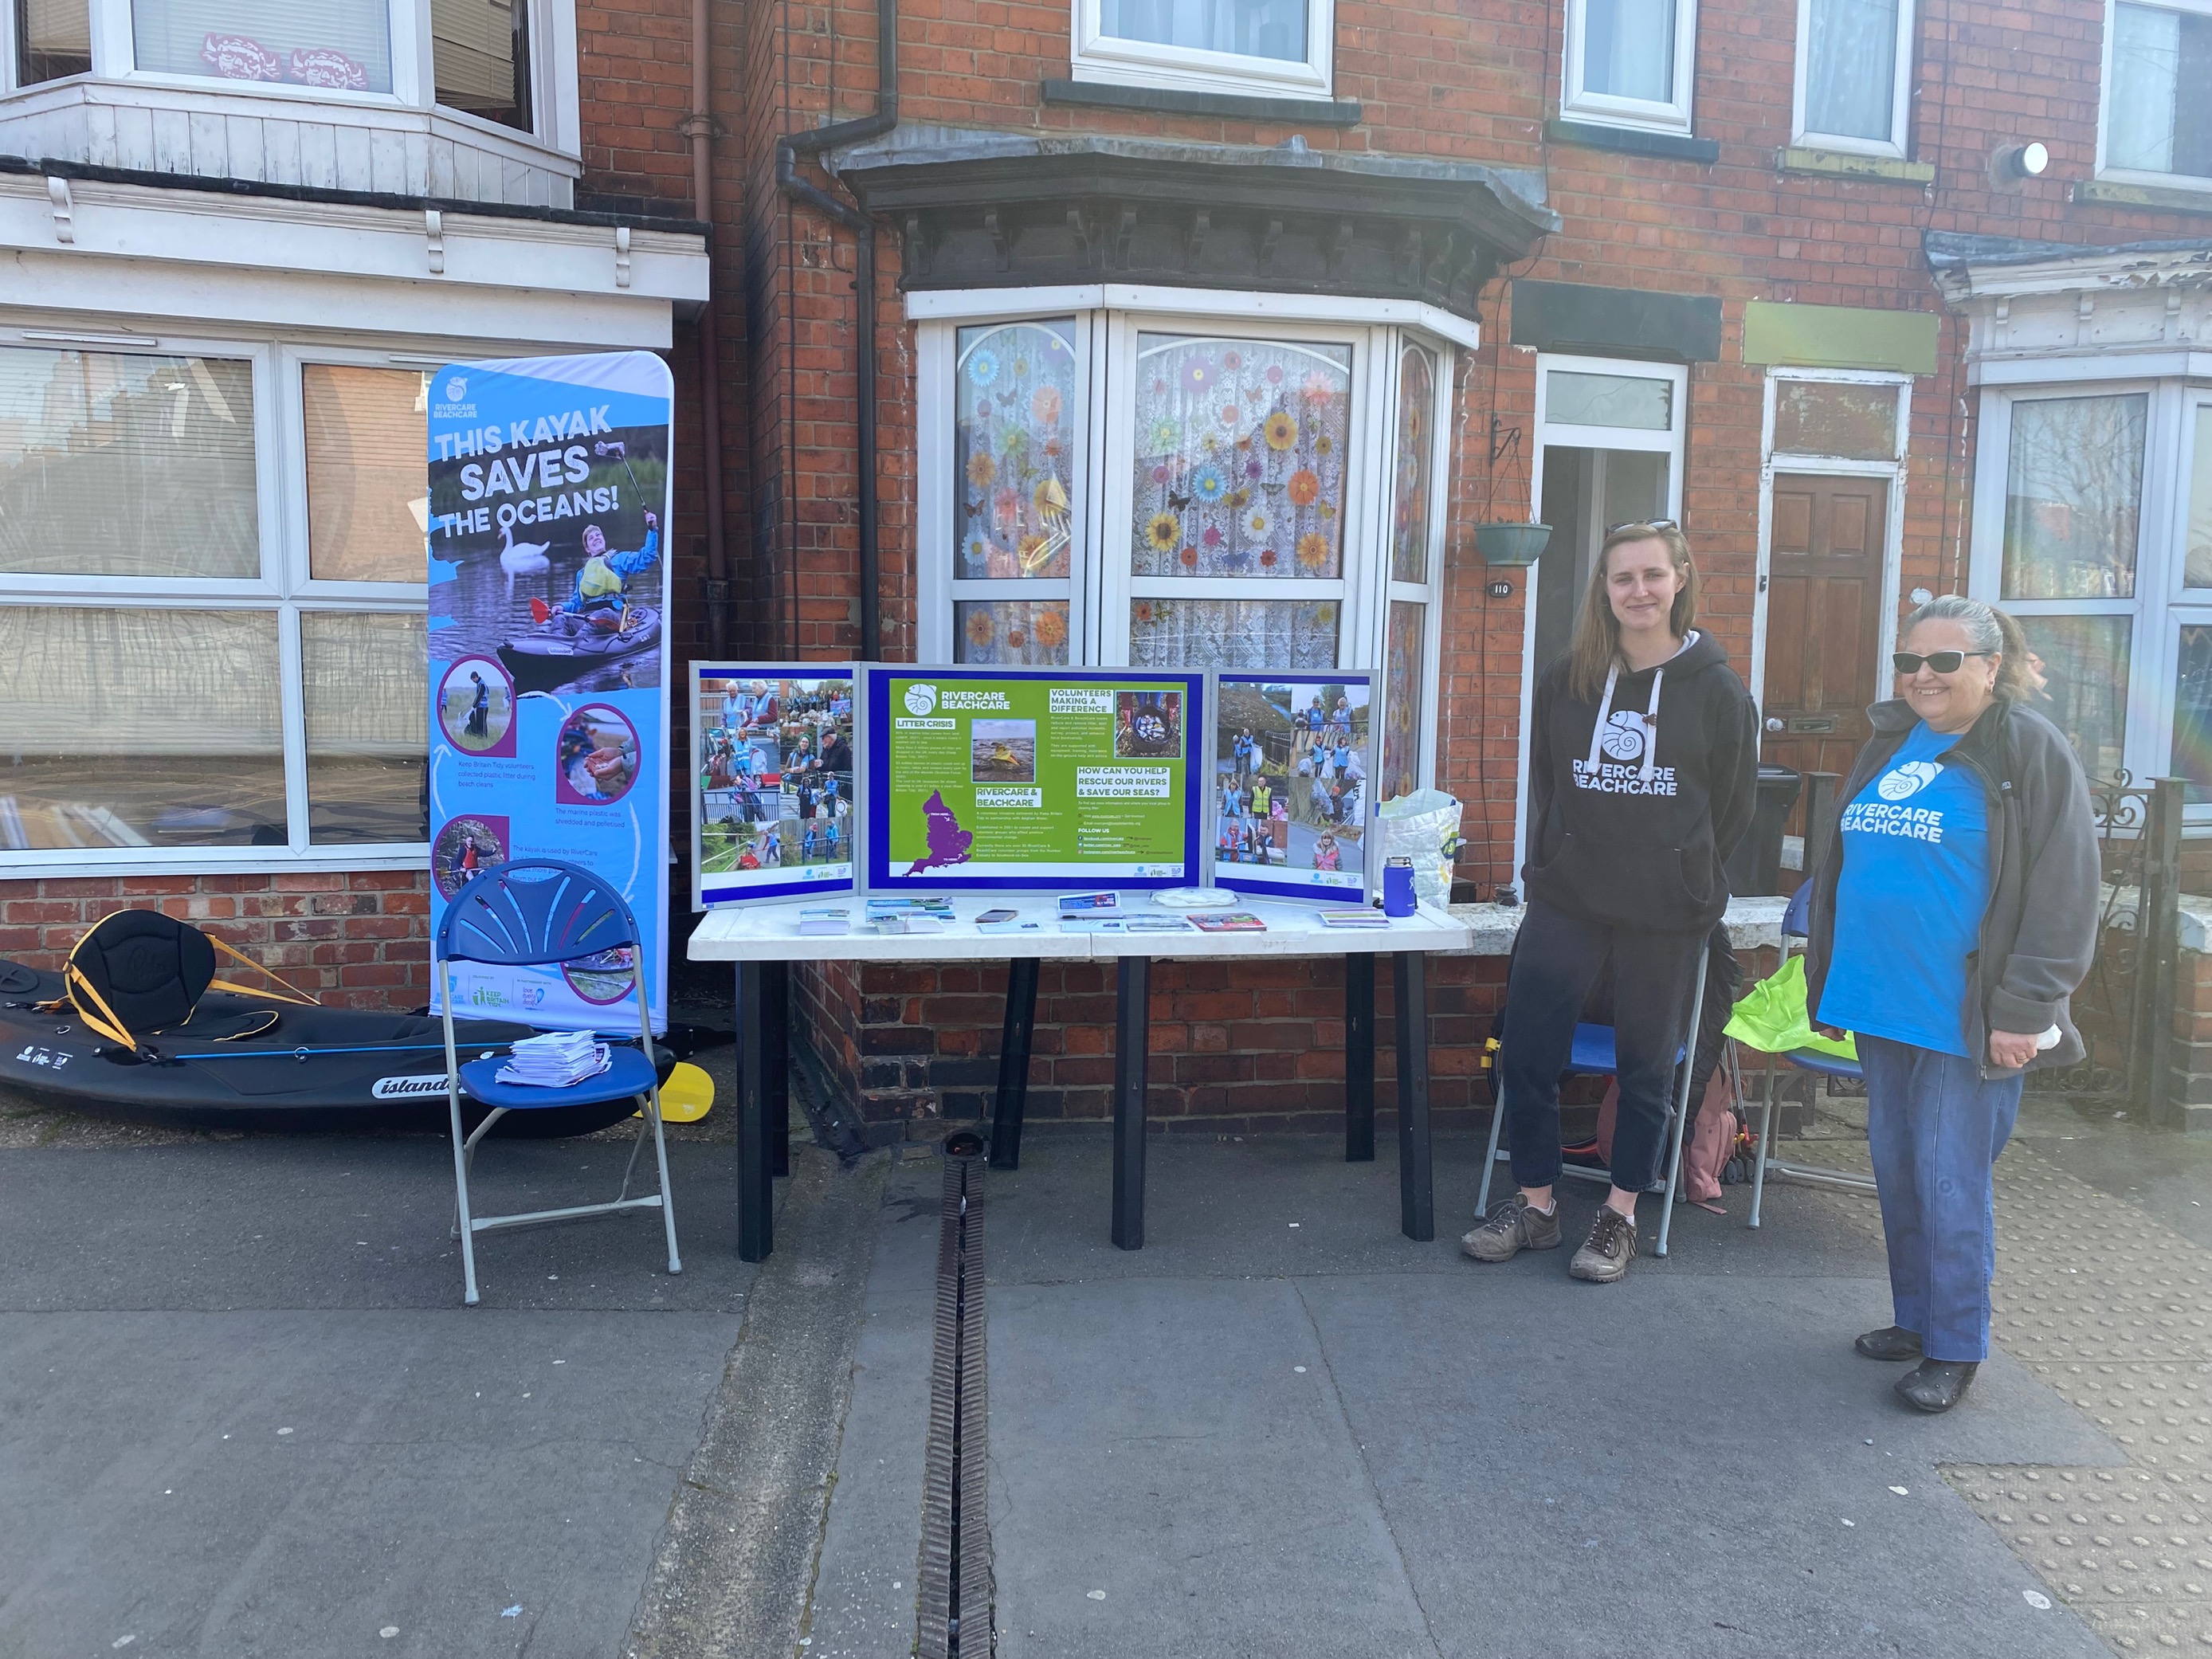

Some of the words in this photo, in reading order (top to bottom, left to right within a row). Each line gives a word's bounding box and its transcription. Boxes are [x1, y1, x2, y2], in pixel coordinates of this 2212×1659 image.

[434, 426, 503, 461] THIS
[510, 405, 612, 449] KAYAK
[460, 445, 590, 501] SAVES
[439, 507, 491, 538] THE
[496, 485, 619, 528] OCEANS!
[942, 692, 1005, 700] RIVERCARE
[942, 700, 1010, 709] BEACHCARE
[1573, 774, 1677, 796] BEACHCARE
[1844, 803, 1943, 826] RIVERCARE
[1841, 817, 1943, 843] BEACHCARE
